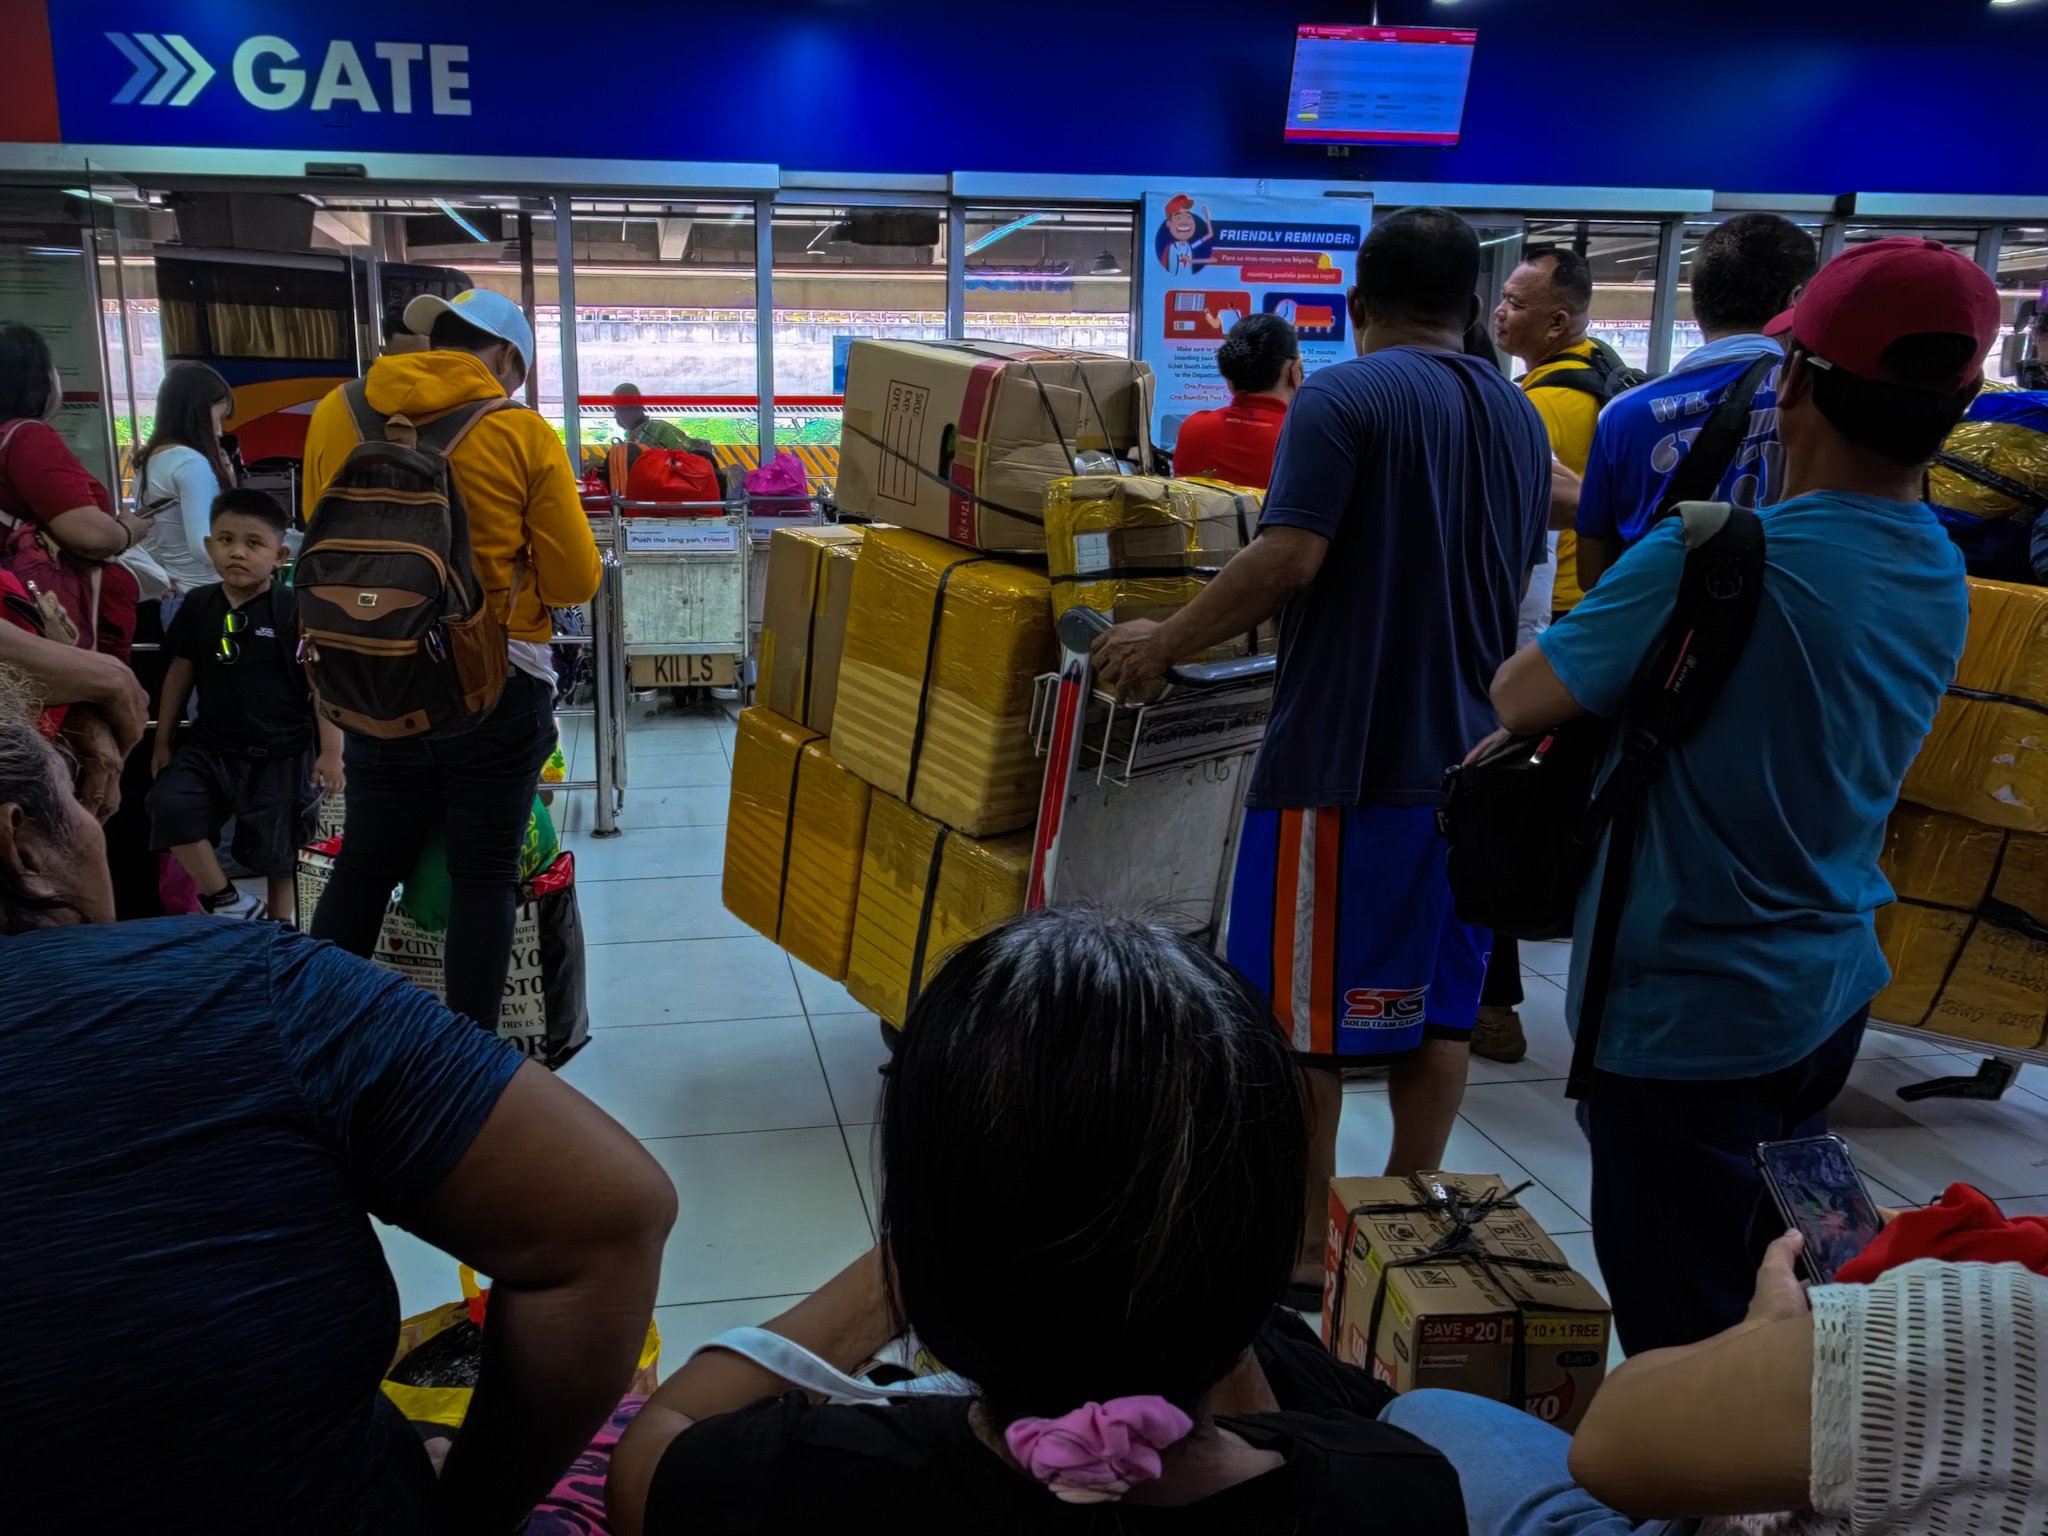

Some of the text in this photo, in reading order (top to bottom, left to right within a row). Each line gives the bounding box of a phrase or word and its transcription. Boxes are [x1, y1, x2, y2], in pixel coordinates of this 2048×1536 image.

[232, 35, 472, 117] GATE
[1219, 229, 1355, 244] FRIENDLY REMINDER:
[1221, 254, 1236, 262] Para
[1174, 354, 1200, 362] boarding
[891, 387, 902, 412] QTY:
[903, 390, 913, 414] EXP:
[912, 392, 924, 418] SKU:
[655, 655, 713, 683] KILLS
[526, 935, 536, 943] IS
[405, 938, 440, 956] CITY
[1343, 1018, 1370, 1028] SOLID
[1370, 1019, 1397, 1028] TEAM
[1424, 1322, 1462, 1337] SAVE
[1533, 1325, 1546, 1338] 10
[1569, 1324, 1600, 1338] FREE
